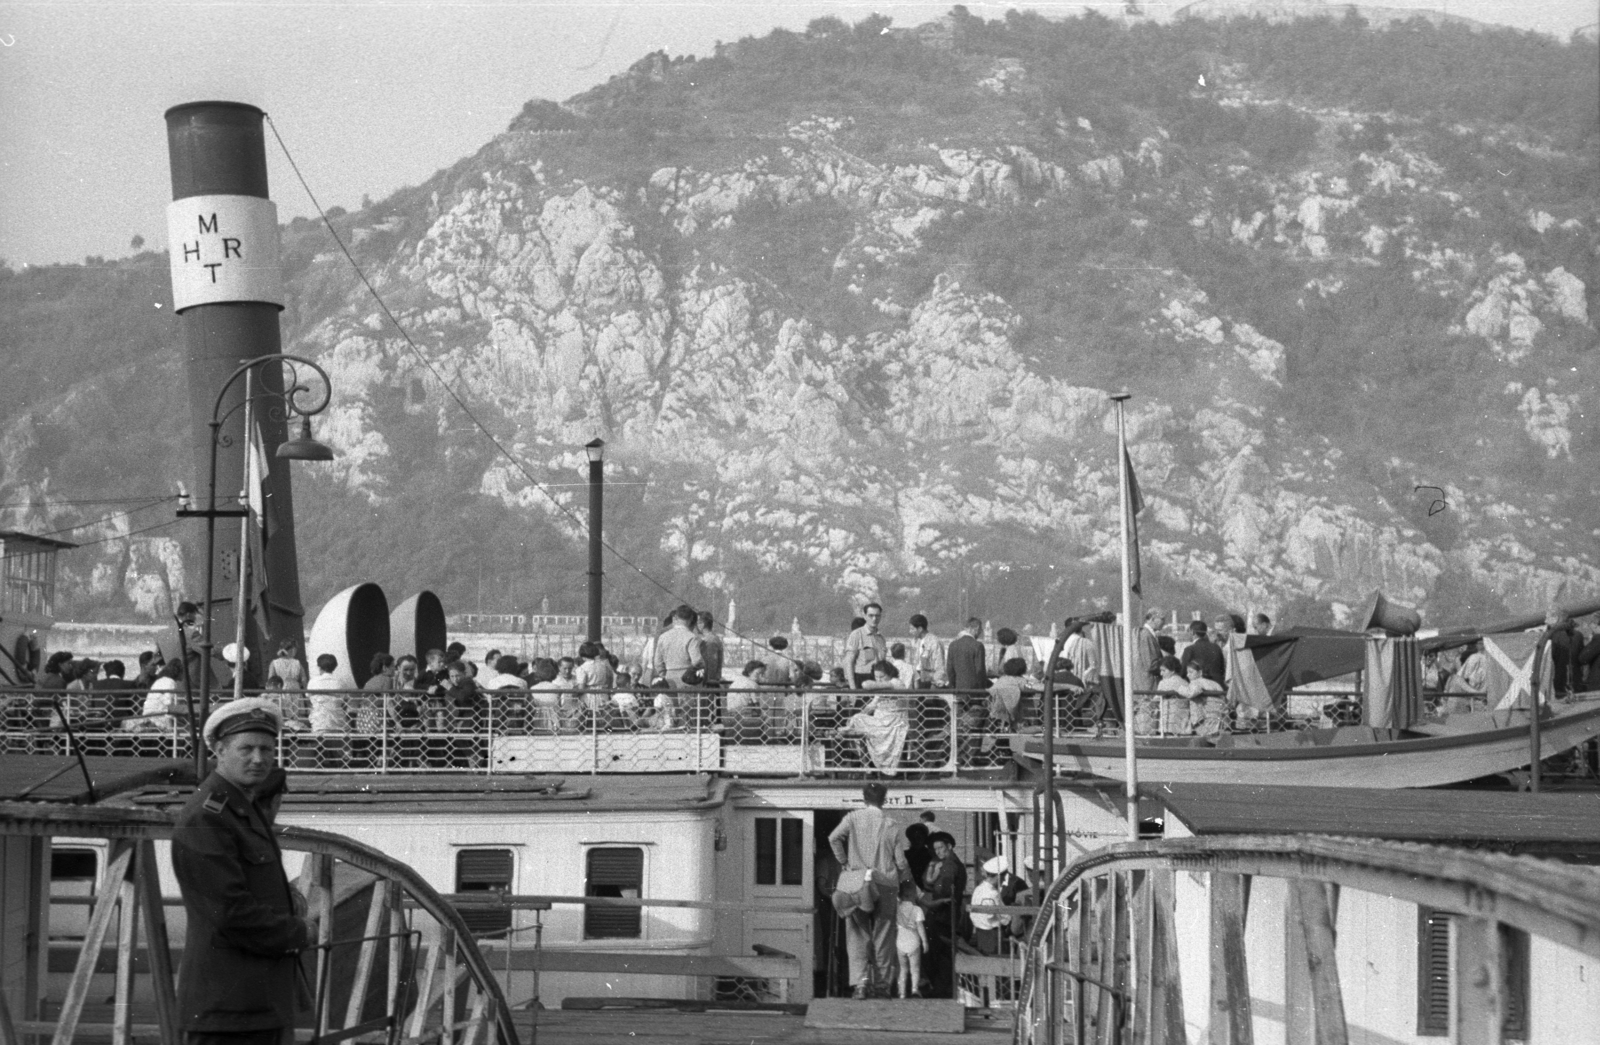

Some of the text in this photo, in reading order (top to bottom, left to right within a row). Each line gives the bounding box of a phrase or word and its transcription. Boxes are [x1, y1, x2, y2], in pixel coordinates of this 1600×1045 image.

[198, 212, 218, 234] M
[183, 238, 242, 263] H R
[203, 263, 222, 284] T
